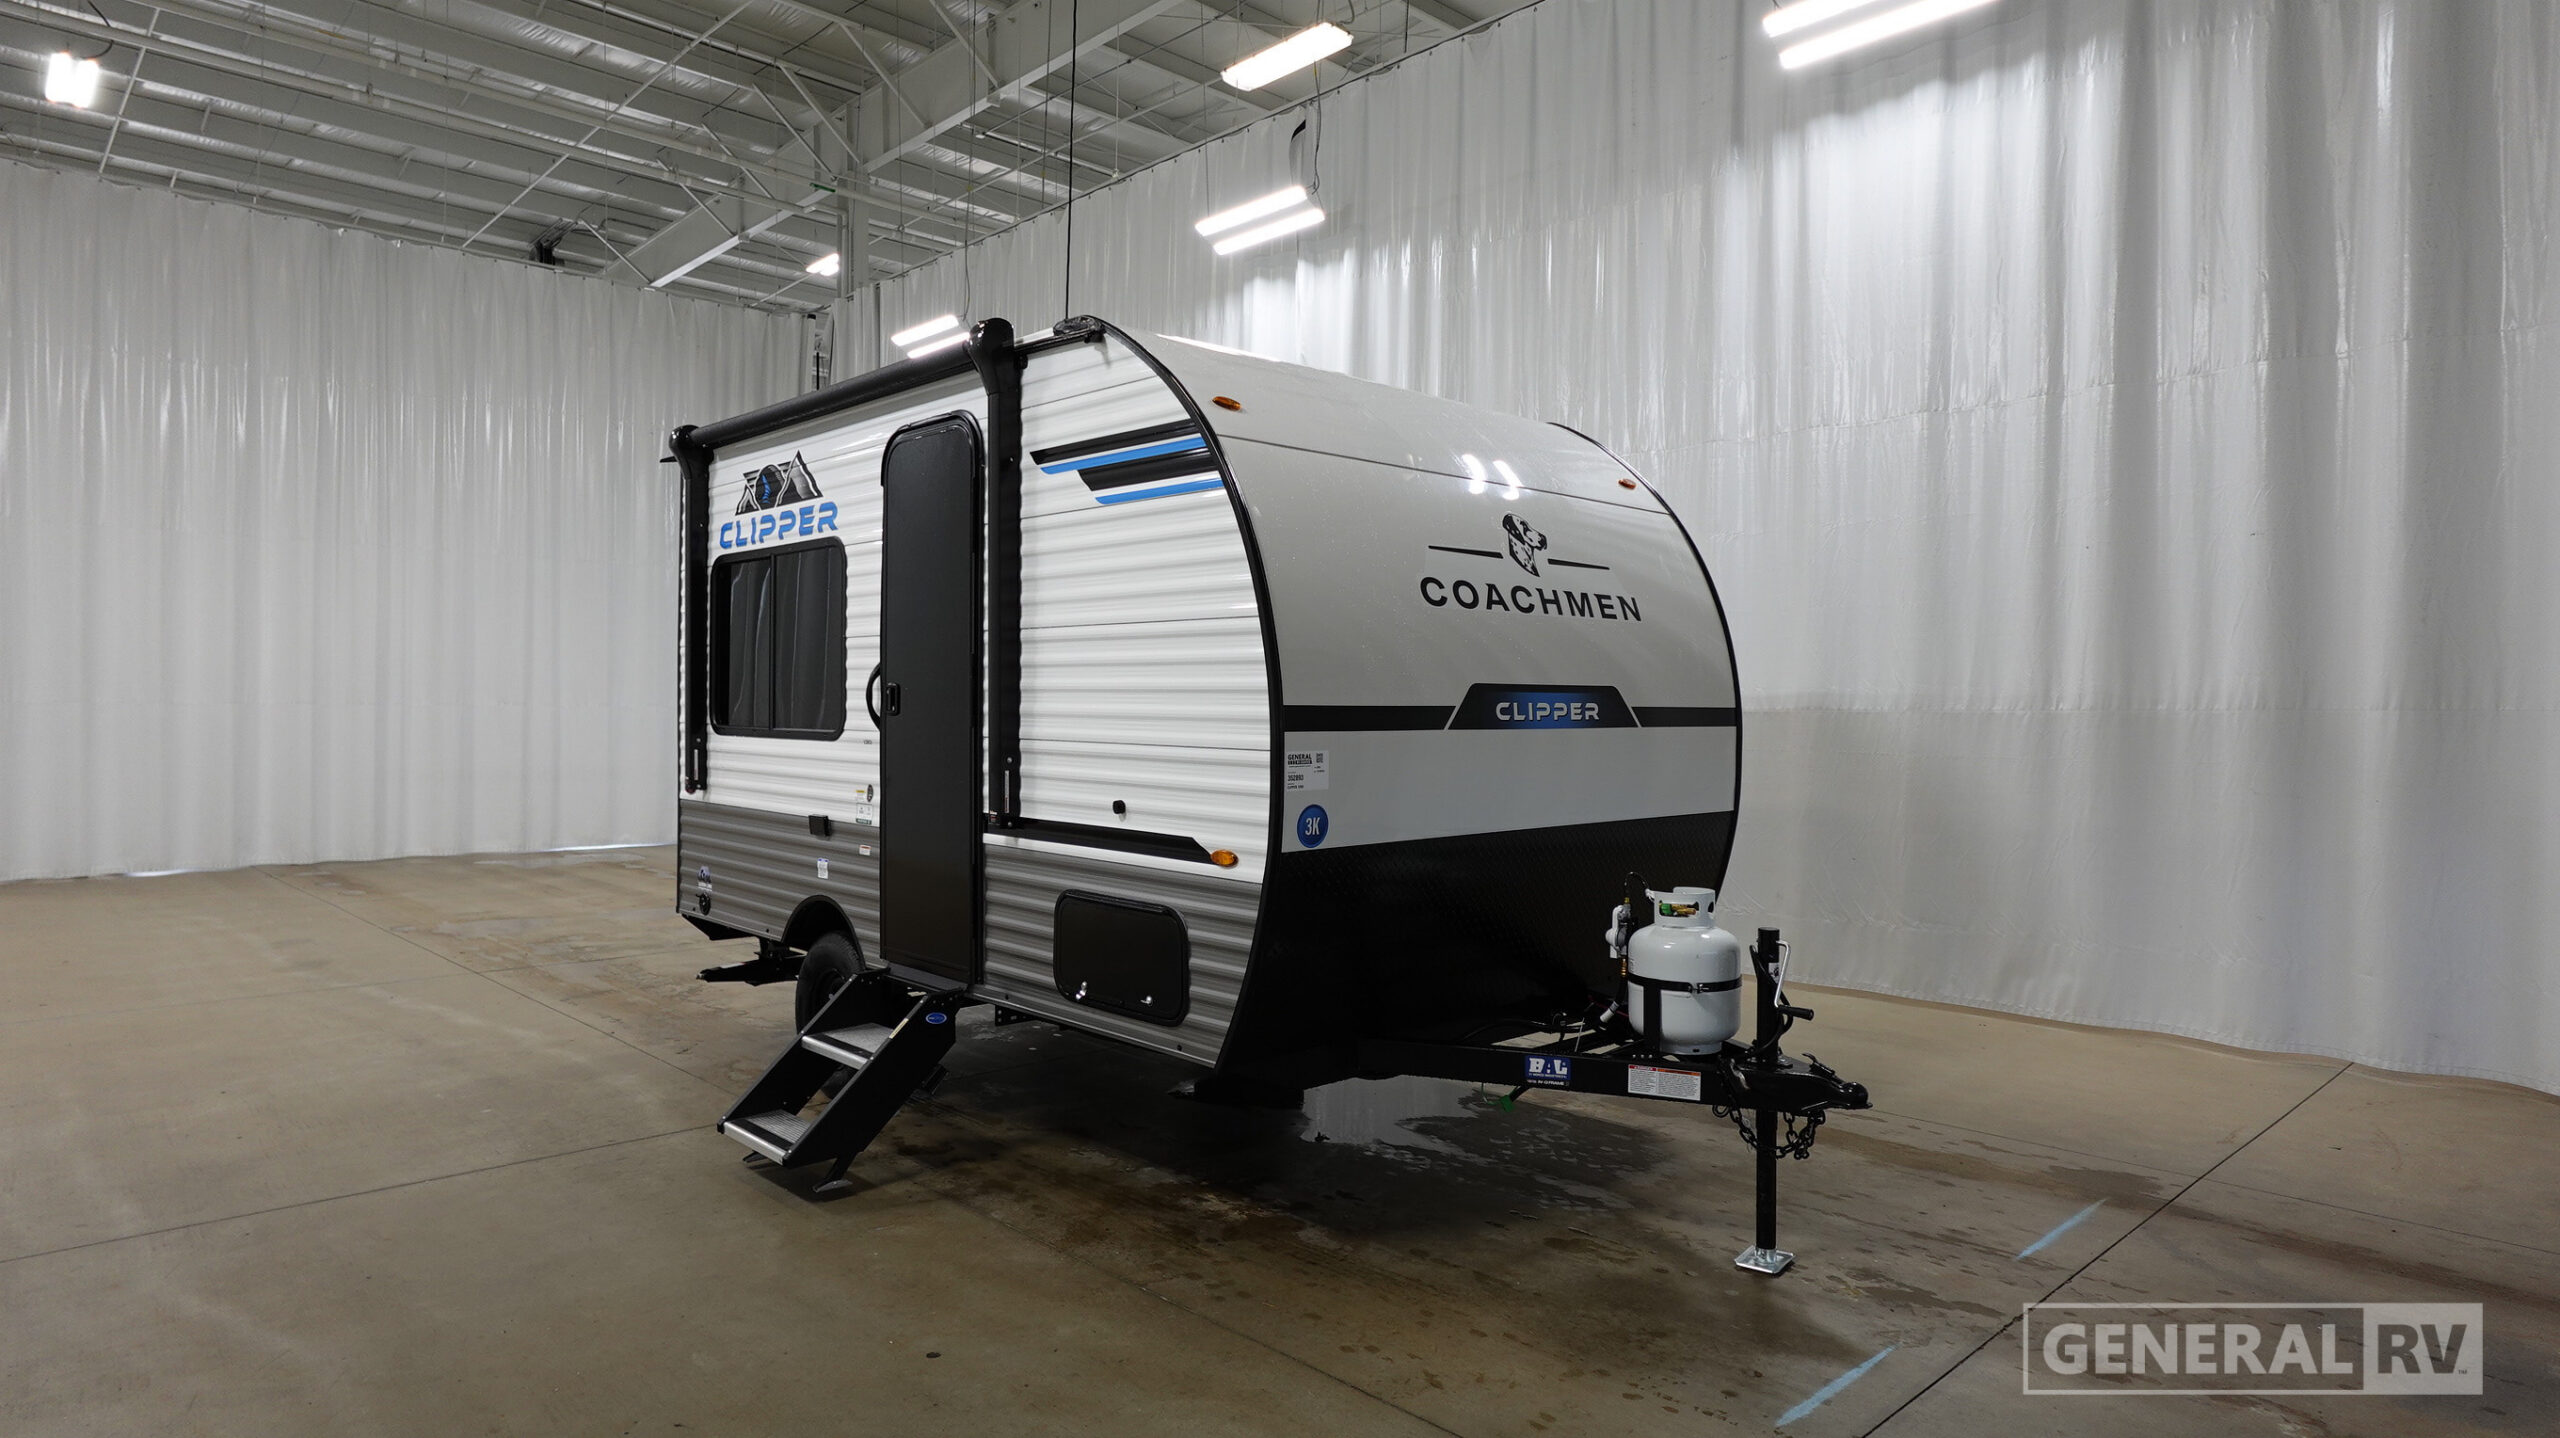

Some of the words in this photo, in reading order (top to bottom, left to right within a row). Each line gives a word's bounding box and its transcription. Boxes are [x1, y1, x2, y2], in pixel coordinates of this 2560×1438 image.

[719, 501, 839, 550] CLIPPER
[1420, 577, 1642, 622] COACHMEN
[1495, 702, 1600, 722] CLIPPER
[1287, 753, 1312, 761] GENERAL
[1305, 817, 1320, 836] 3K
